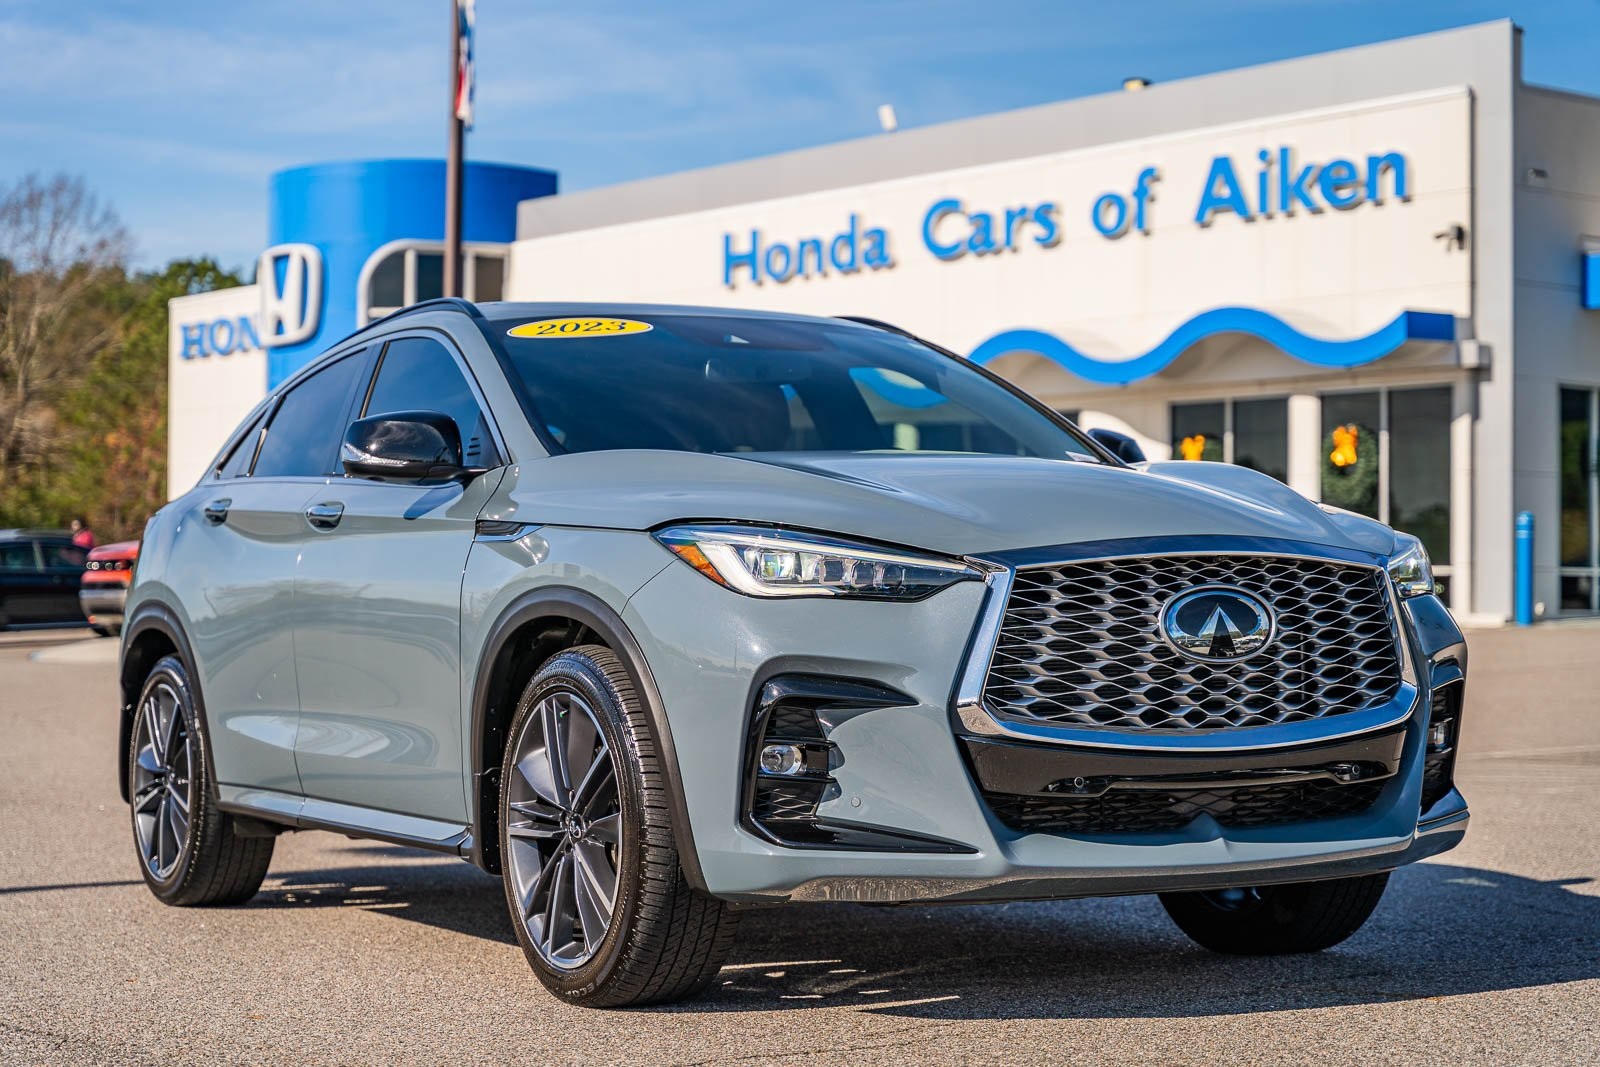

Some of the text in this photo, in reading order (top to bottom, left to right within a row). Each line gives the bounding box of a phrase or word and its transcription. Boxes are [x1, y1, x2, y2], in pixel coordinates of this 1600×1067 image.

[722, 146, 1409, 287] Honda Cars of Aiken
[536, 321, 628, 336] 2023
